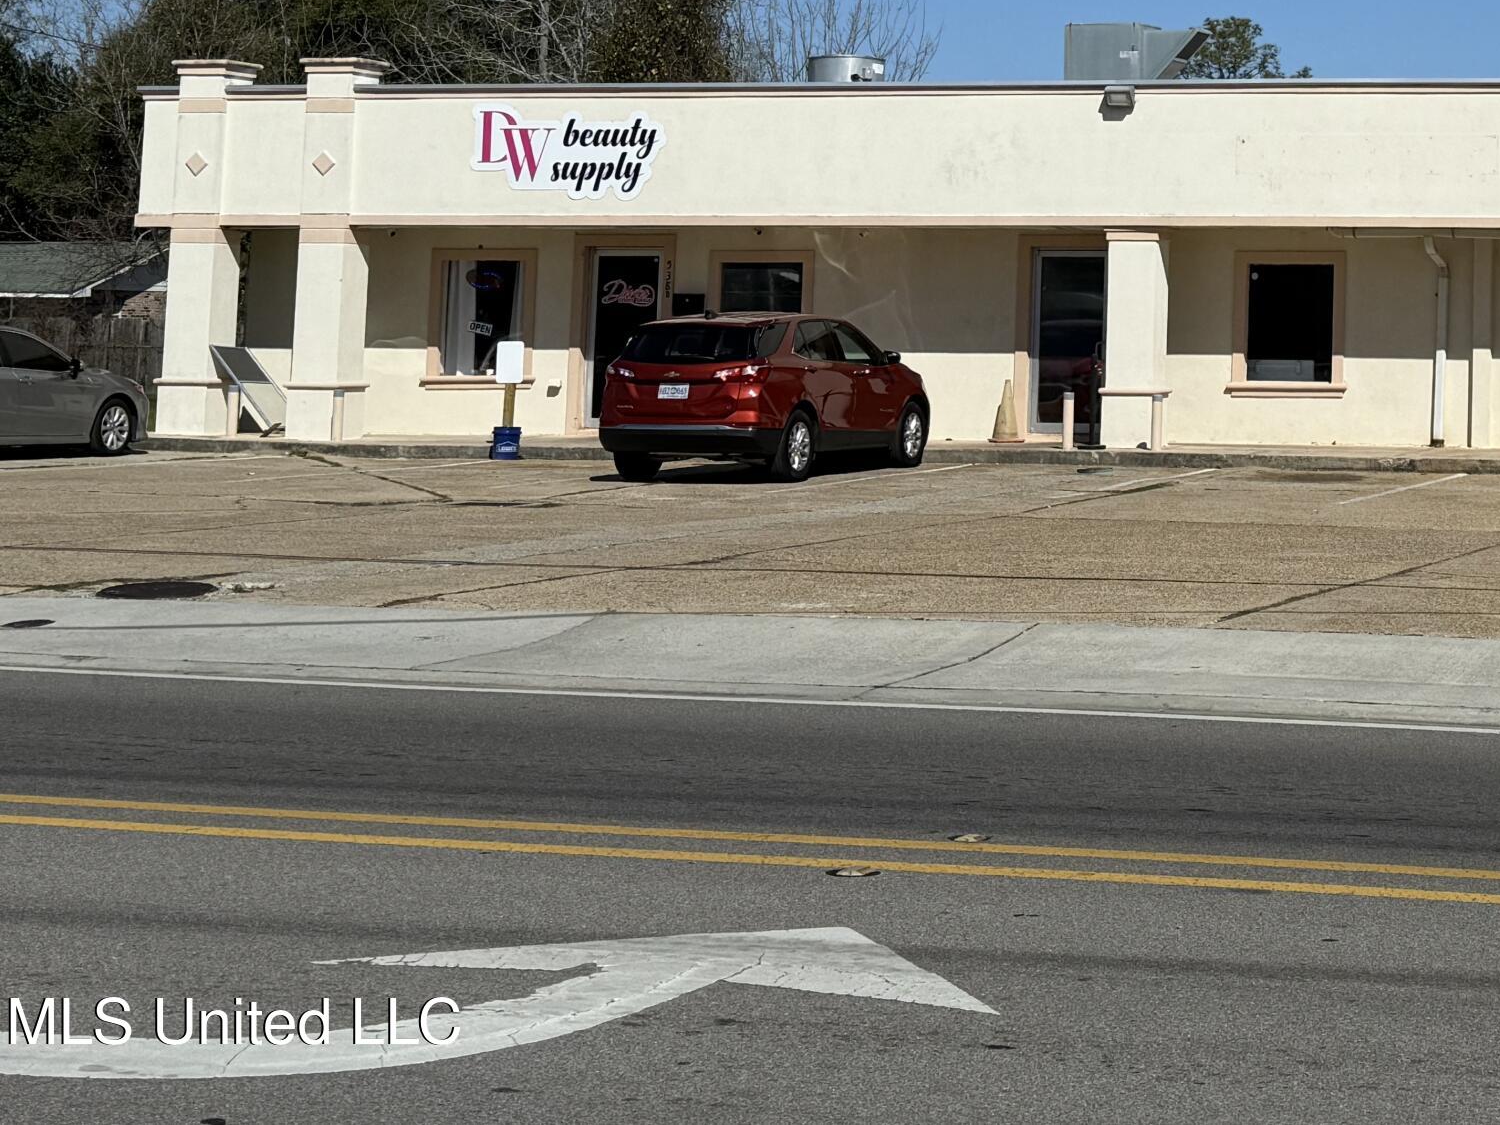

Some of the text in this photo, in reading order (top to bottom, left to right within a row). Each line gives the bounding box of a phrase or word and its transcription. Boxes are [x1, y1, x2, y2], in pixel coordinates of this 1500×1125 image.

[478, 110, 659, 182] DW beauty
[550, 151, 643, 193] supply
[469, 322, 492, 334] OPEN
